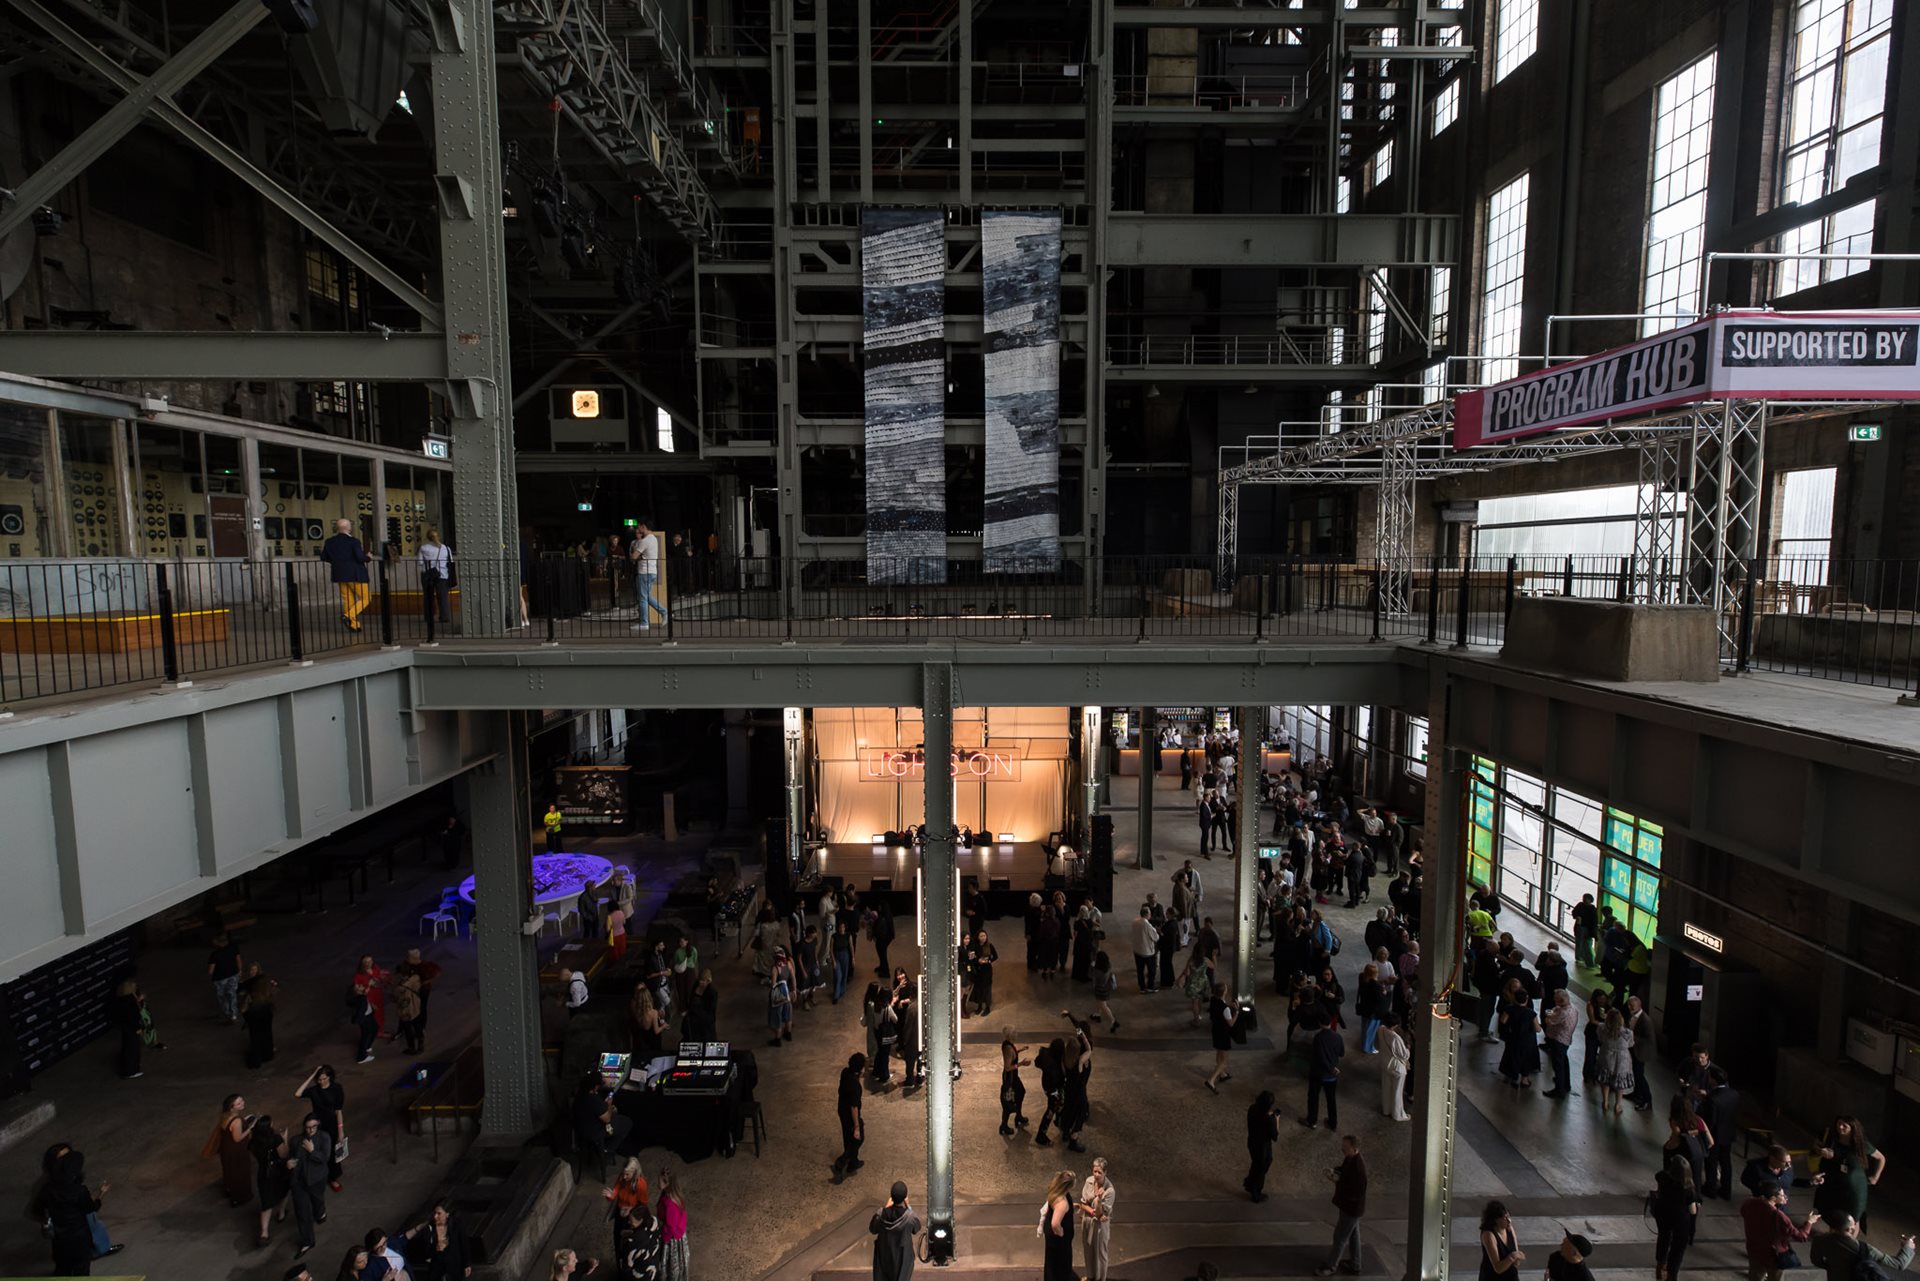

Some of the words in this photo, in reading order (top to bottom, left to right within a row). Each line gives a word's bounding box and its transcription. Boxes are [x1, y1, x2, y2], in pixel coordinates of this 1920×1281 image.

[1732, 331, 1868, 360] SUPPORTED
[1875, 331, 1908, 360] BY
[1494, 356, 1621, 431] PROGRAM
[1625, 335, 1697, 401] HUB
[868, 752, 959, 777] LIGHS
[968, 752, 1013, 777] ON
